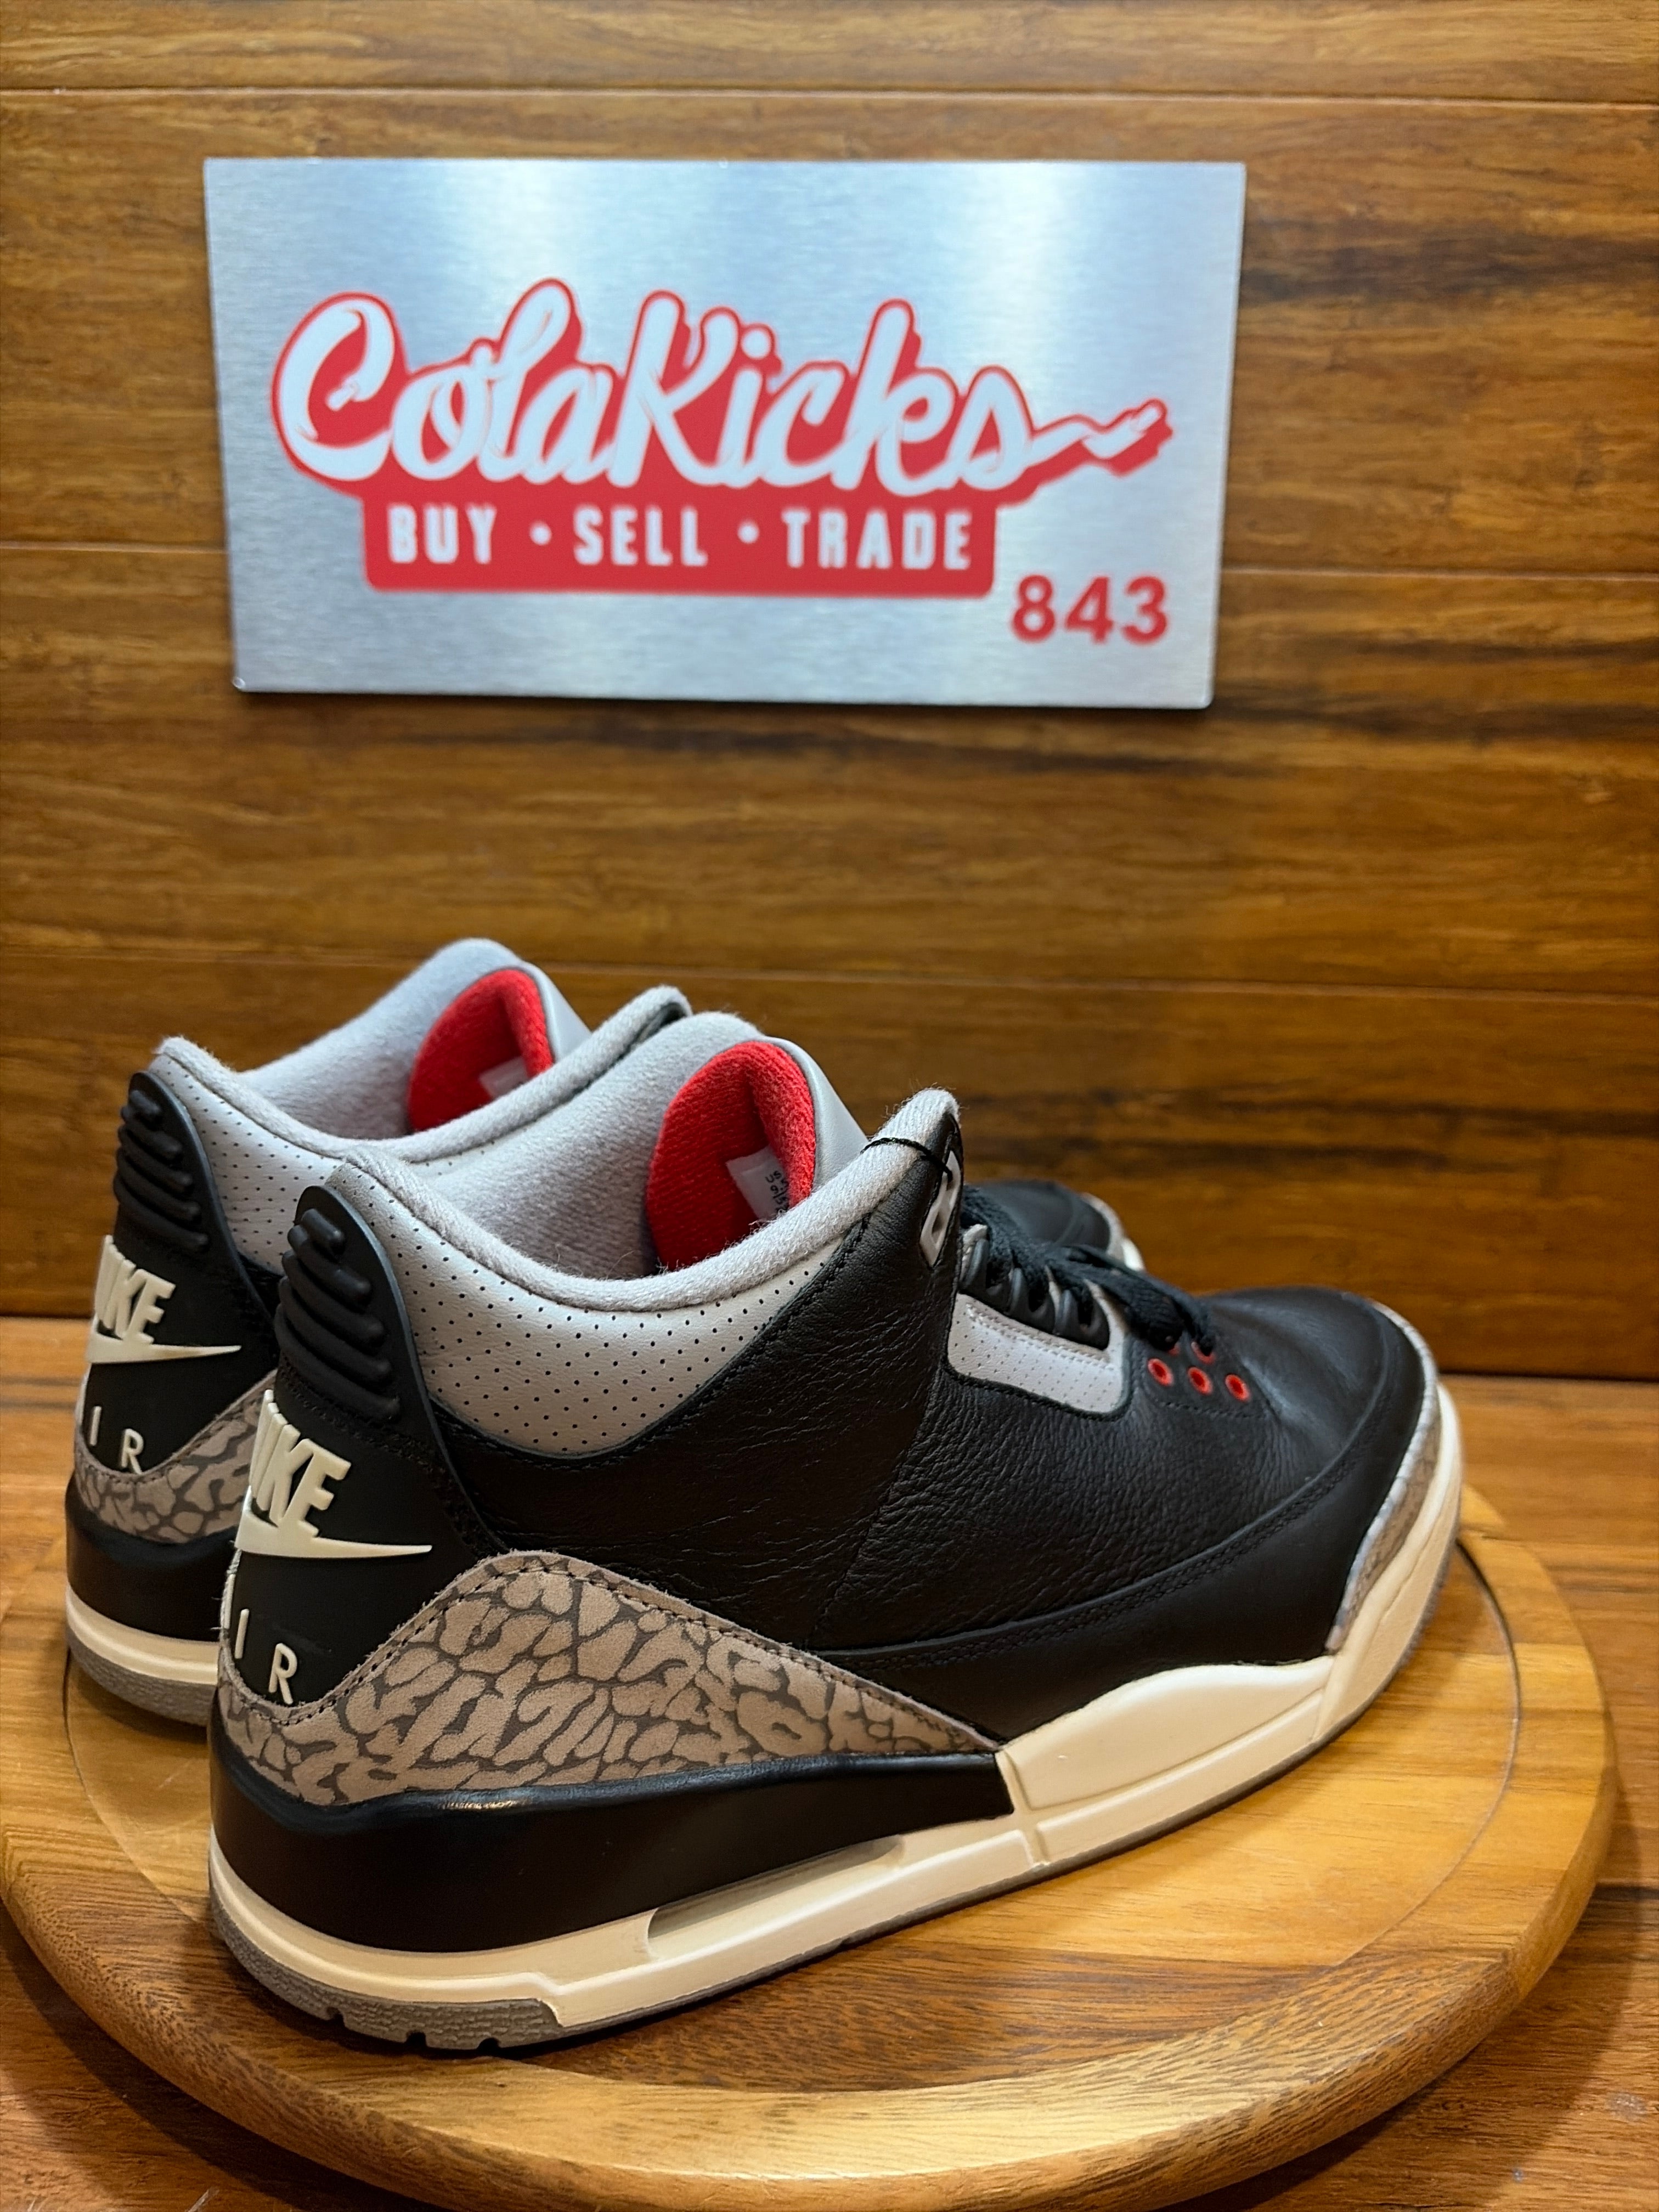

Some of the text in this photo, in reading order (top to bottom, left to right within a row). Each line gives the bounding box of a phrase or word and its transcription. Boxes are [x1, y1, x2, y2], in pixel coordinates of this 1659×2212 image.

[387, 506, 972, 571] BUY SELL TRADE
[1011, 574, 1170, 646] 843
